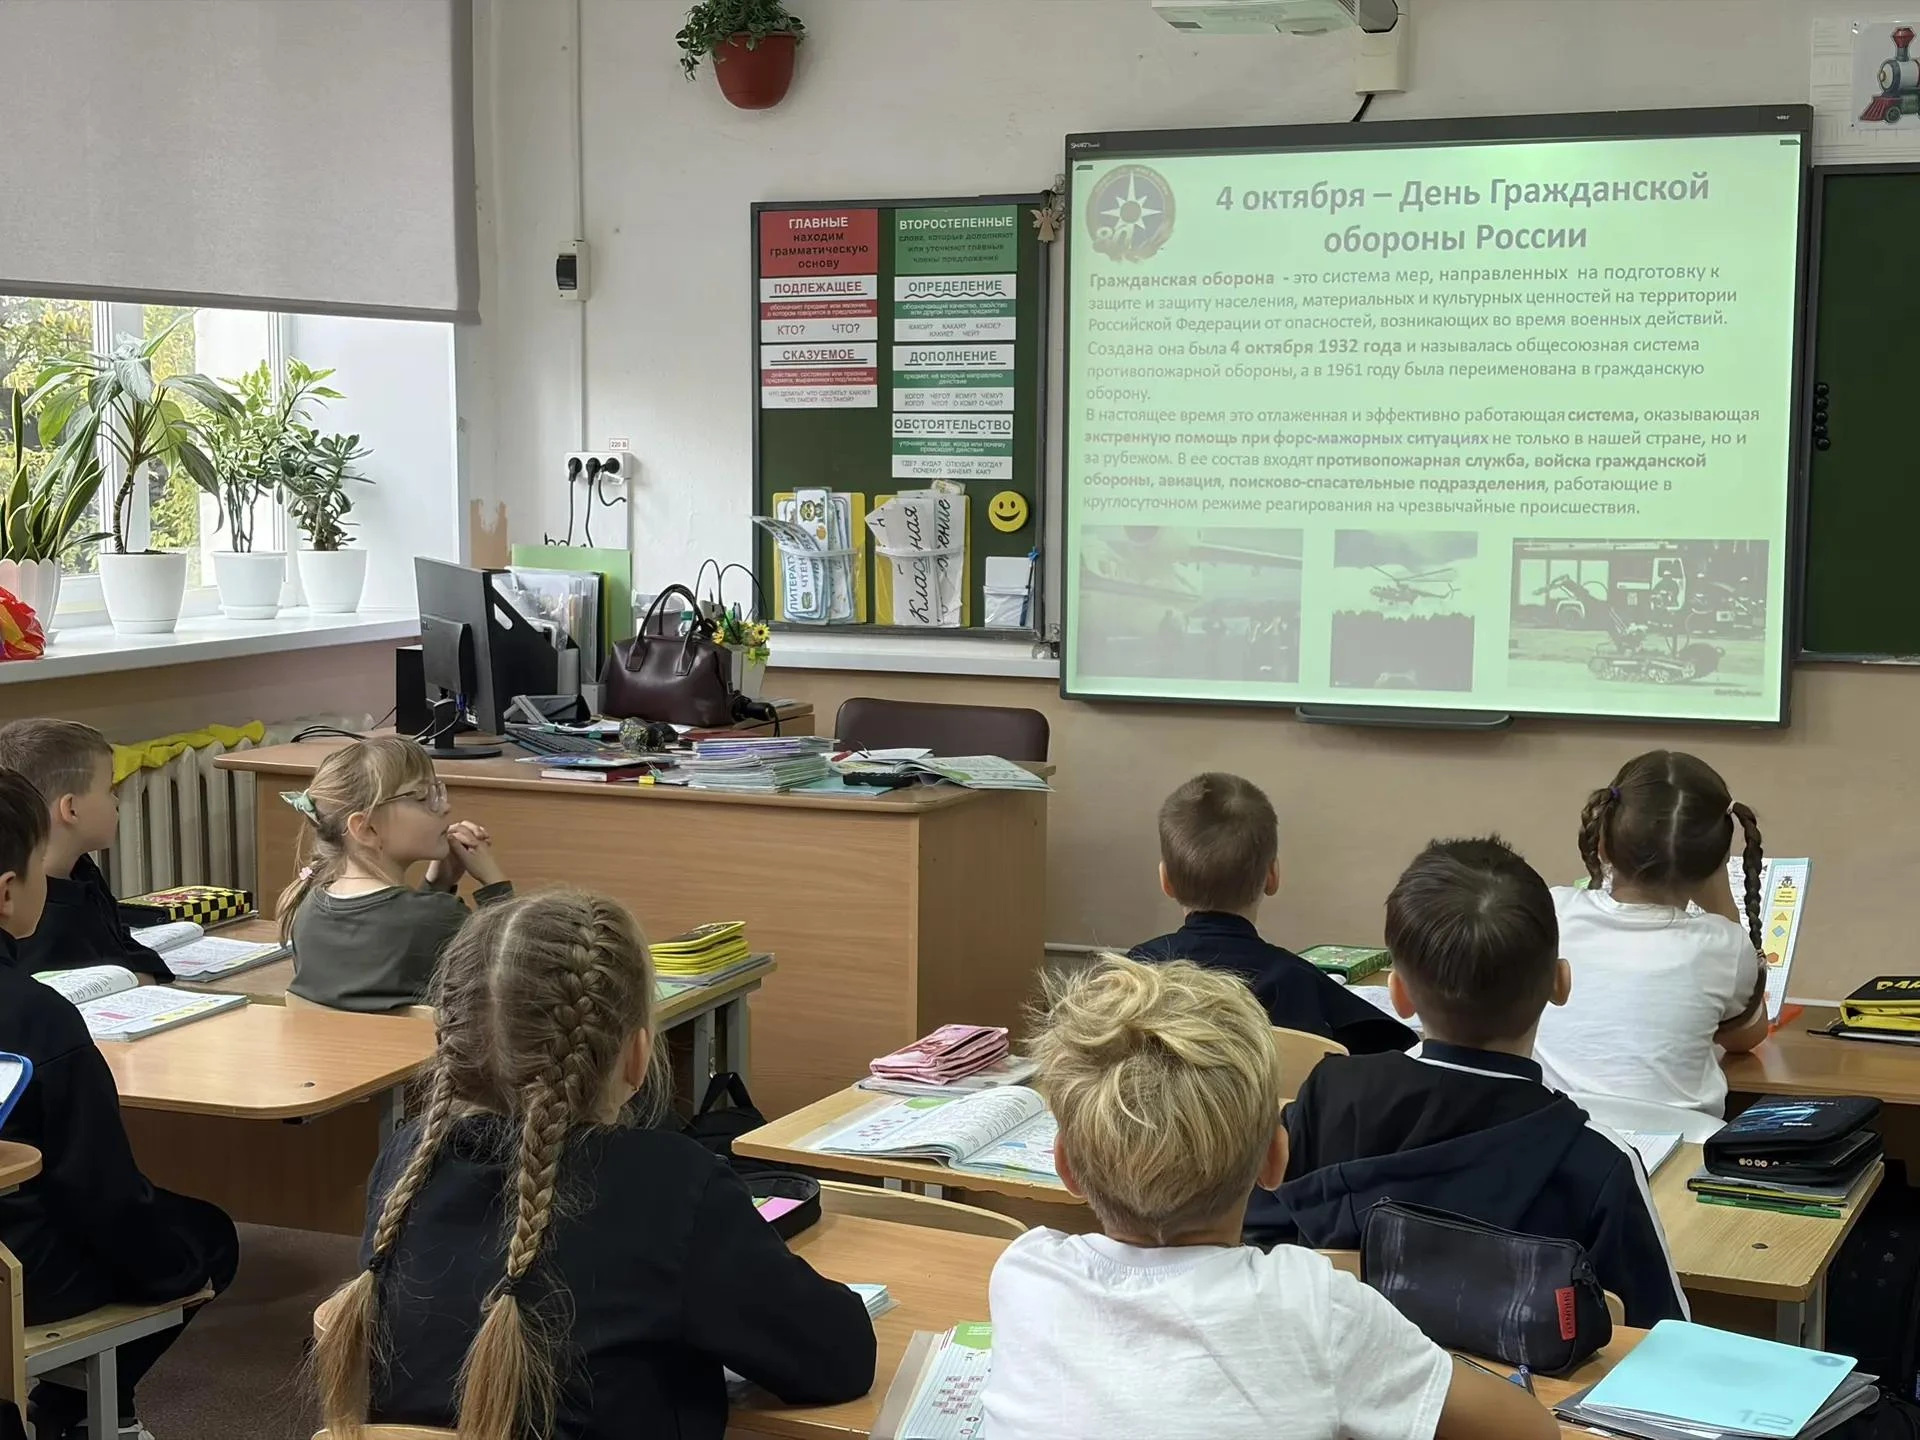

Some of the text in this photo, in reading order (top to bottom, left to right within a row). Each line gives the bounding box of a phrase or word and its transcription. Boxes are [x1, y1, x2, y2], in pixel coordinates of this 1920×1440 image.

[1215, 186, 1233, 210] 4
[1242, 181, 1364, 213] октября
[1398, 181, 1480, 212] День
[1490, 171, 1708, 210] Гражданской
[789, 217, 849, 229] ГЛАВНЫЕ
[899, 216, 1013, 230] ВТОРОСТЕПЕННЫЕ
[793, 233, 844, 243] находим
[1324, 224, 1586, 257] обороны России
[770, 245, 869, 258] грамматическую
[798, 260, 840, 270] основу
[909, 280, 1002, 292] ОПРЕДЕЛЕНИЕ
[1090, 274, 1197, 290] Гражданская
[1201, 271, 1274, 288] оборона
[1293, 273, 1318, 284] это
[1322, 271, 1390, 283] система
[1395, 270, 1433, 284] мер,
[1439, 268, 1568, 283] направленных
[1577, 268, 1598, 279] на
[1604, 267, 1706, 281] подготовку
[1710, 267, 1719, 278] к
[774, 281, 862, 294] ПОДЛЕЖАЩЕЕ
[1088, 288, 1736, 312] защите и защиту населения, материальных и культурных ценностей на территории
[777, 323, 860, 335] КТО? ЧТО?
[1088, 310, 1727, 333] Российской Федерации от опасностей, возникающих во время военных действий.
[782, 349, 855, 360] СКАЗУЕМОЕ
[1087, 337, 1699, 357] Создана она была 4 октября 1932 года и называлась общесоюзная система
[910, 351, 997, 363] ДОПОЛНЕНИЕ
[1087, 361, 1704, 380] противопожарной обороны, а в 1961 году была переименована в гражданскую
[1086, 385, 1151, 403] оборону.
[1086, 407, 1759, 424] В настоящее время это отлаженная и эффективно работающая система, оказывающая
[894, 419, 1011, 430] ОБСТОЯТЕЛЬСТВО
[1084, 430, 1746, 448] экстренную помощь при форс-мажорных ситуациях не только в нашей стране, но и
[1085, 450, 1706, 470] за рубежом. В ее состав входят противопожарная служба, войска гражданской
[1083, 472, 1672, 493] обороны, авиация, поисково-спасательные подразделения, работающие в
[1083, 497, 1639, 515] круглосуточном режиме реагирования на чрезвычайные происшествия.
